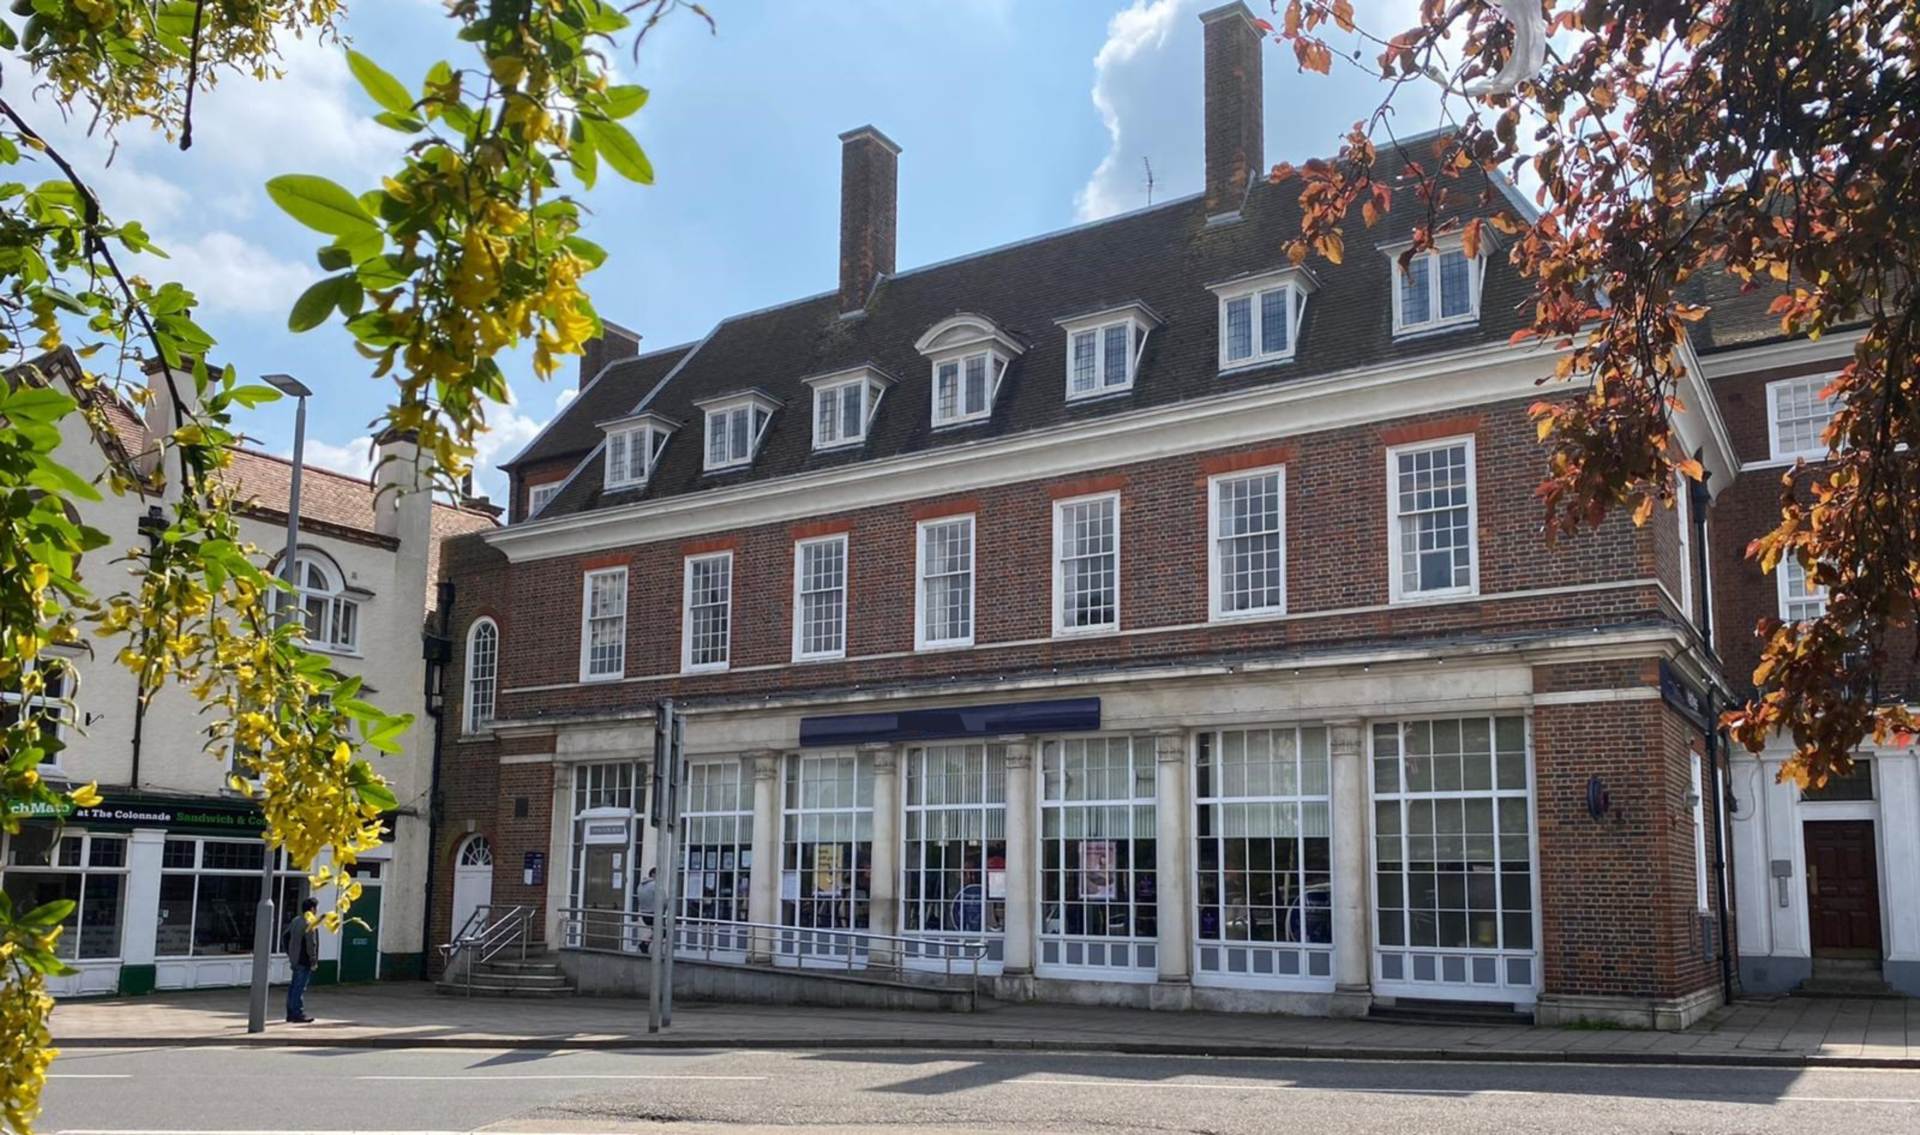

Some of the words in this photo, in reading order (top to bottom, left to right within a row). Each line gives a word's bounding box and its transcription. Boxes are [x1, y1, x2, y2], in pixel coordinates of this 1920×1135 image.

[77, 809, 88, 817] at
[91, 809, 112, 818] The
[115, 810, 171, 821] Colonnade
[176, 812, 234, 825] Sandwich
[237, 816, 245, 825] &
[248, 816, 266, 826] Co
